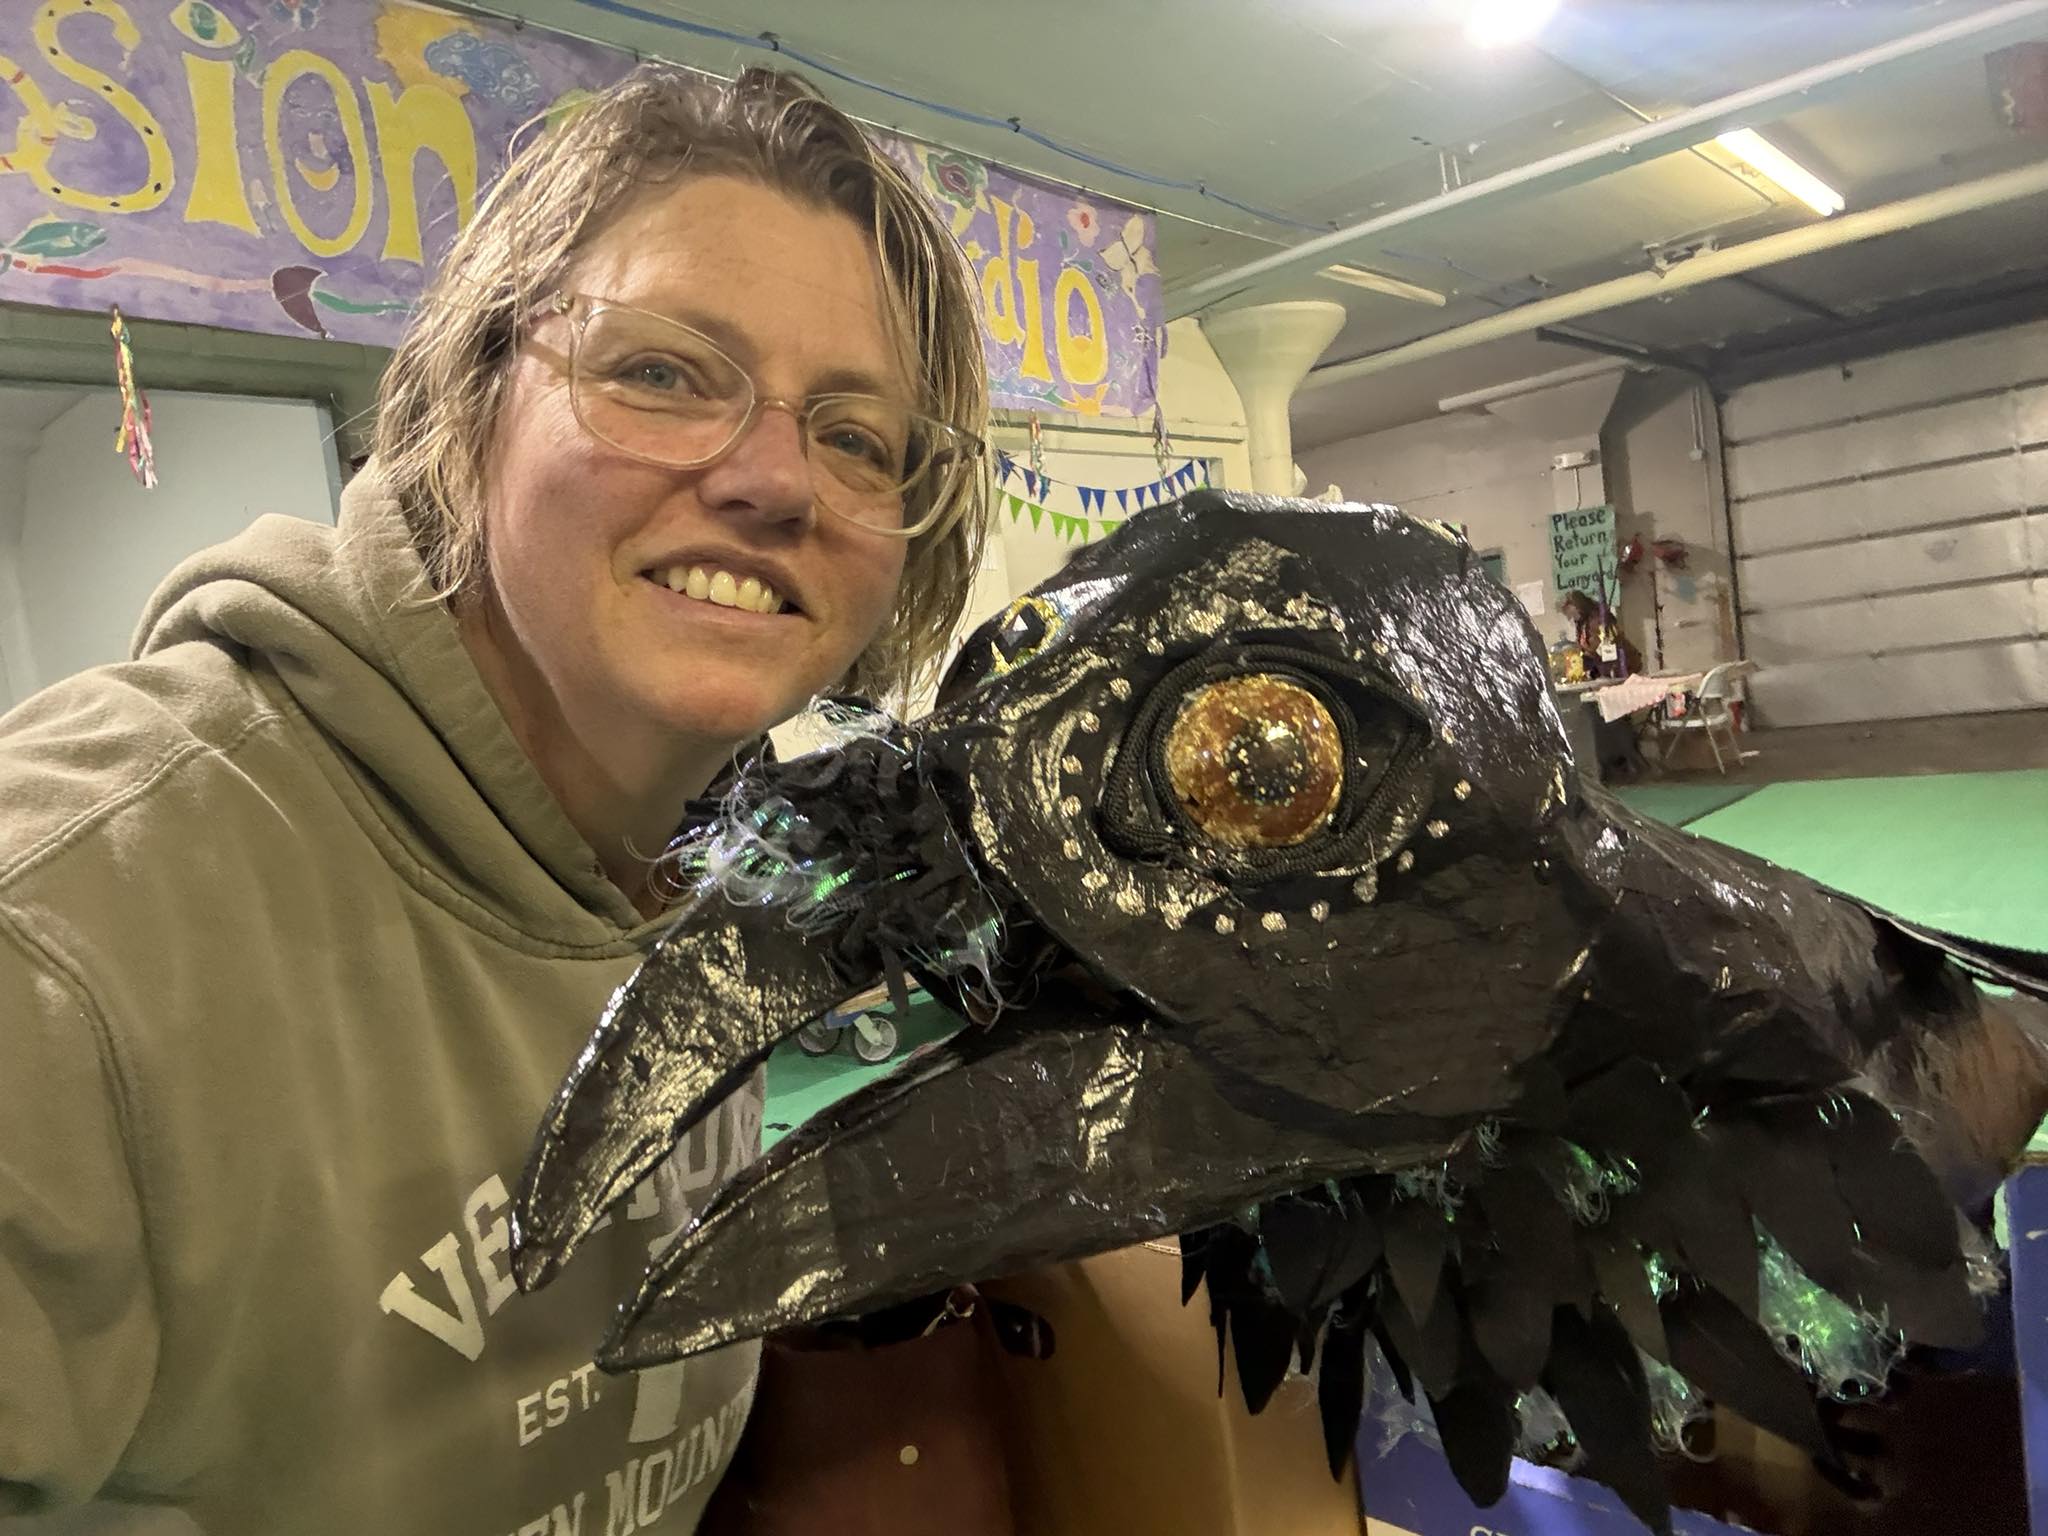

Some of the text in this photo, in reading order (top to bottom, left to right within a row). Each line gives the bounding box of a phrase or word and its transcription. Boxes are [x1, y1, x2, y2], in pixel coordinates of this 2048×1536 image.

[983, 194, 1108, 385] dio
[1552, 509, 1605, 532] Please
[1553, 530, 1606, 553] Return
[1555, 553, 1587, 569] Your
[1556, 561, 1614, 590] Lanyad
[517, 1362, 600, 1447] EST.
